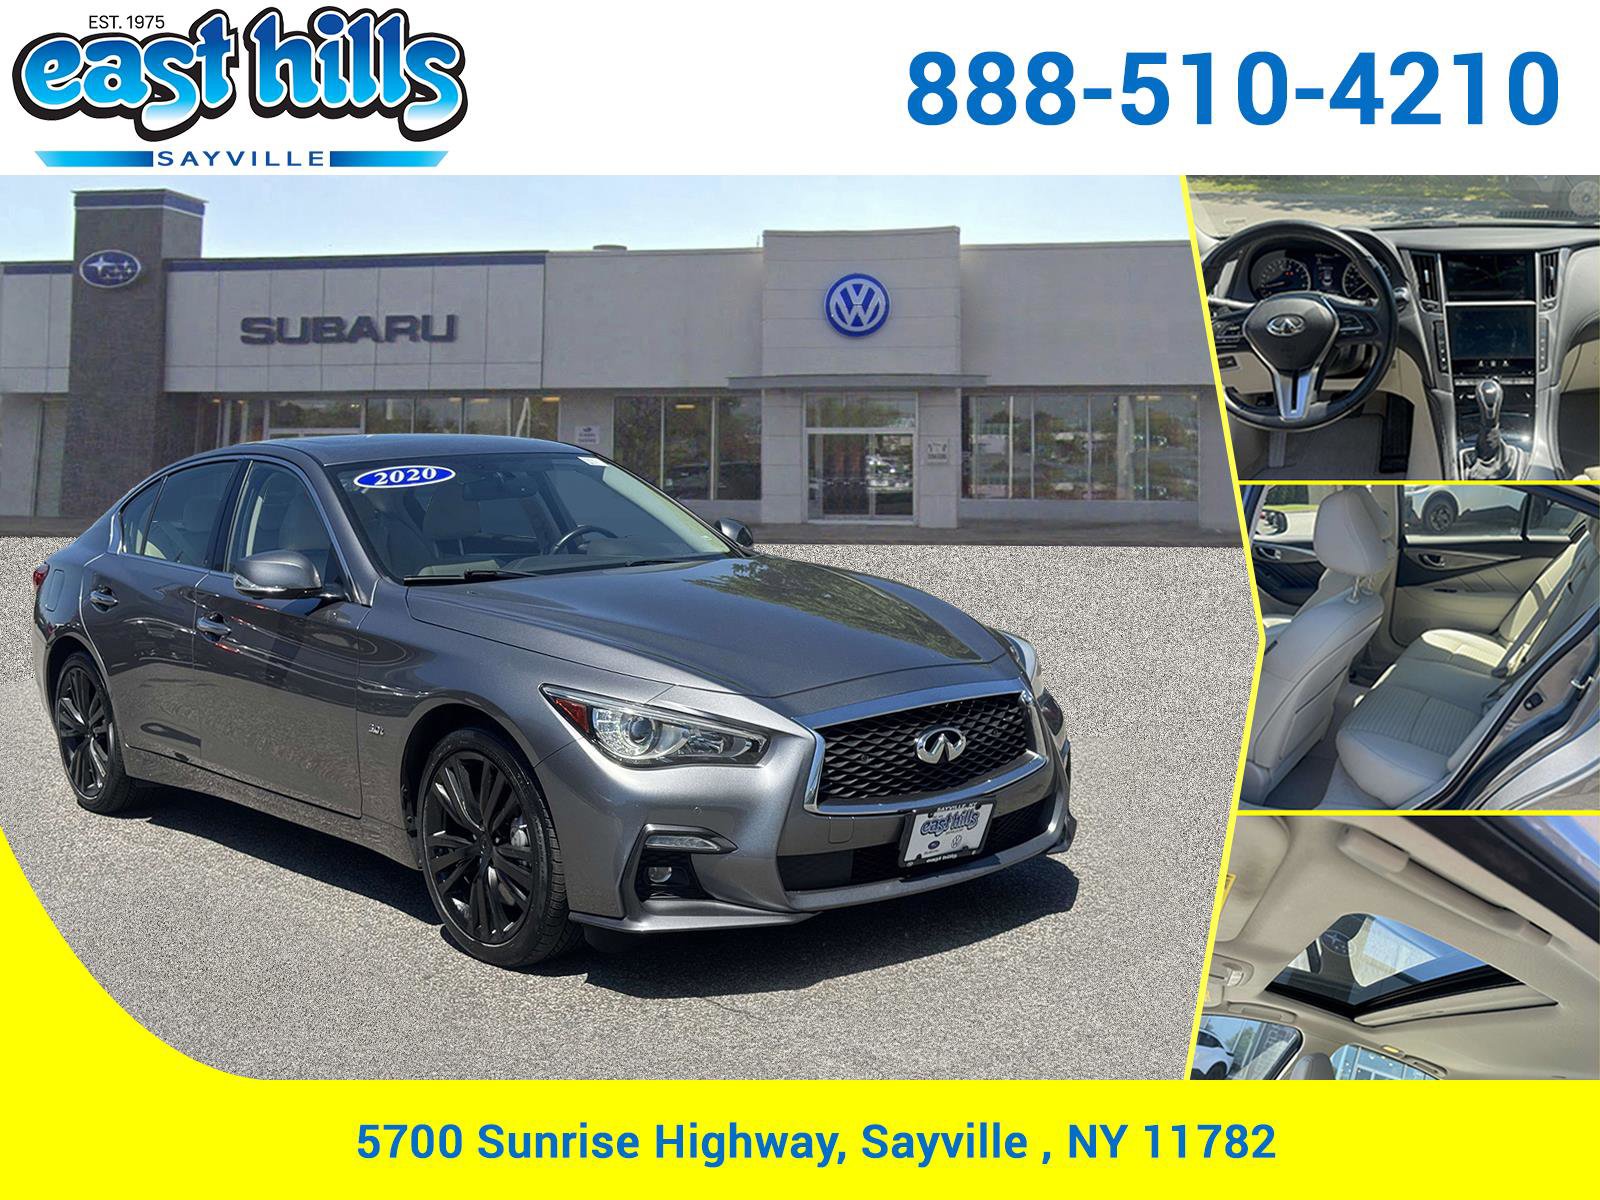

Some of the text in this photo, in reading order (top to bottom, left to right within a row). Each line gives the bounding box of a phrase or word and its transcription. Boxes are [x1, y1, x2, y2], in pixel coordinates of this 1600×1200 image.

[240, 314, 458, 345] SUBARU
[374, 467, 437, 485] 2020
[920, 808, 980, 837] east hills
